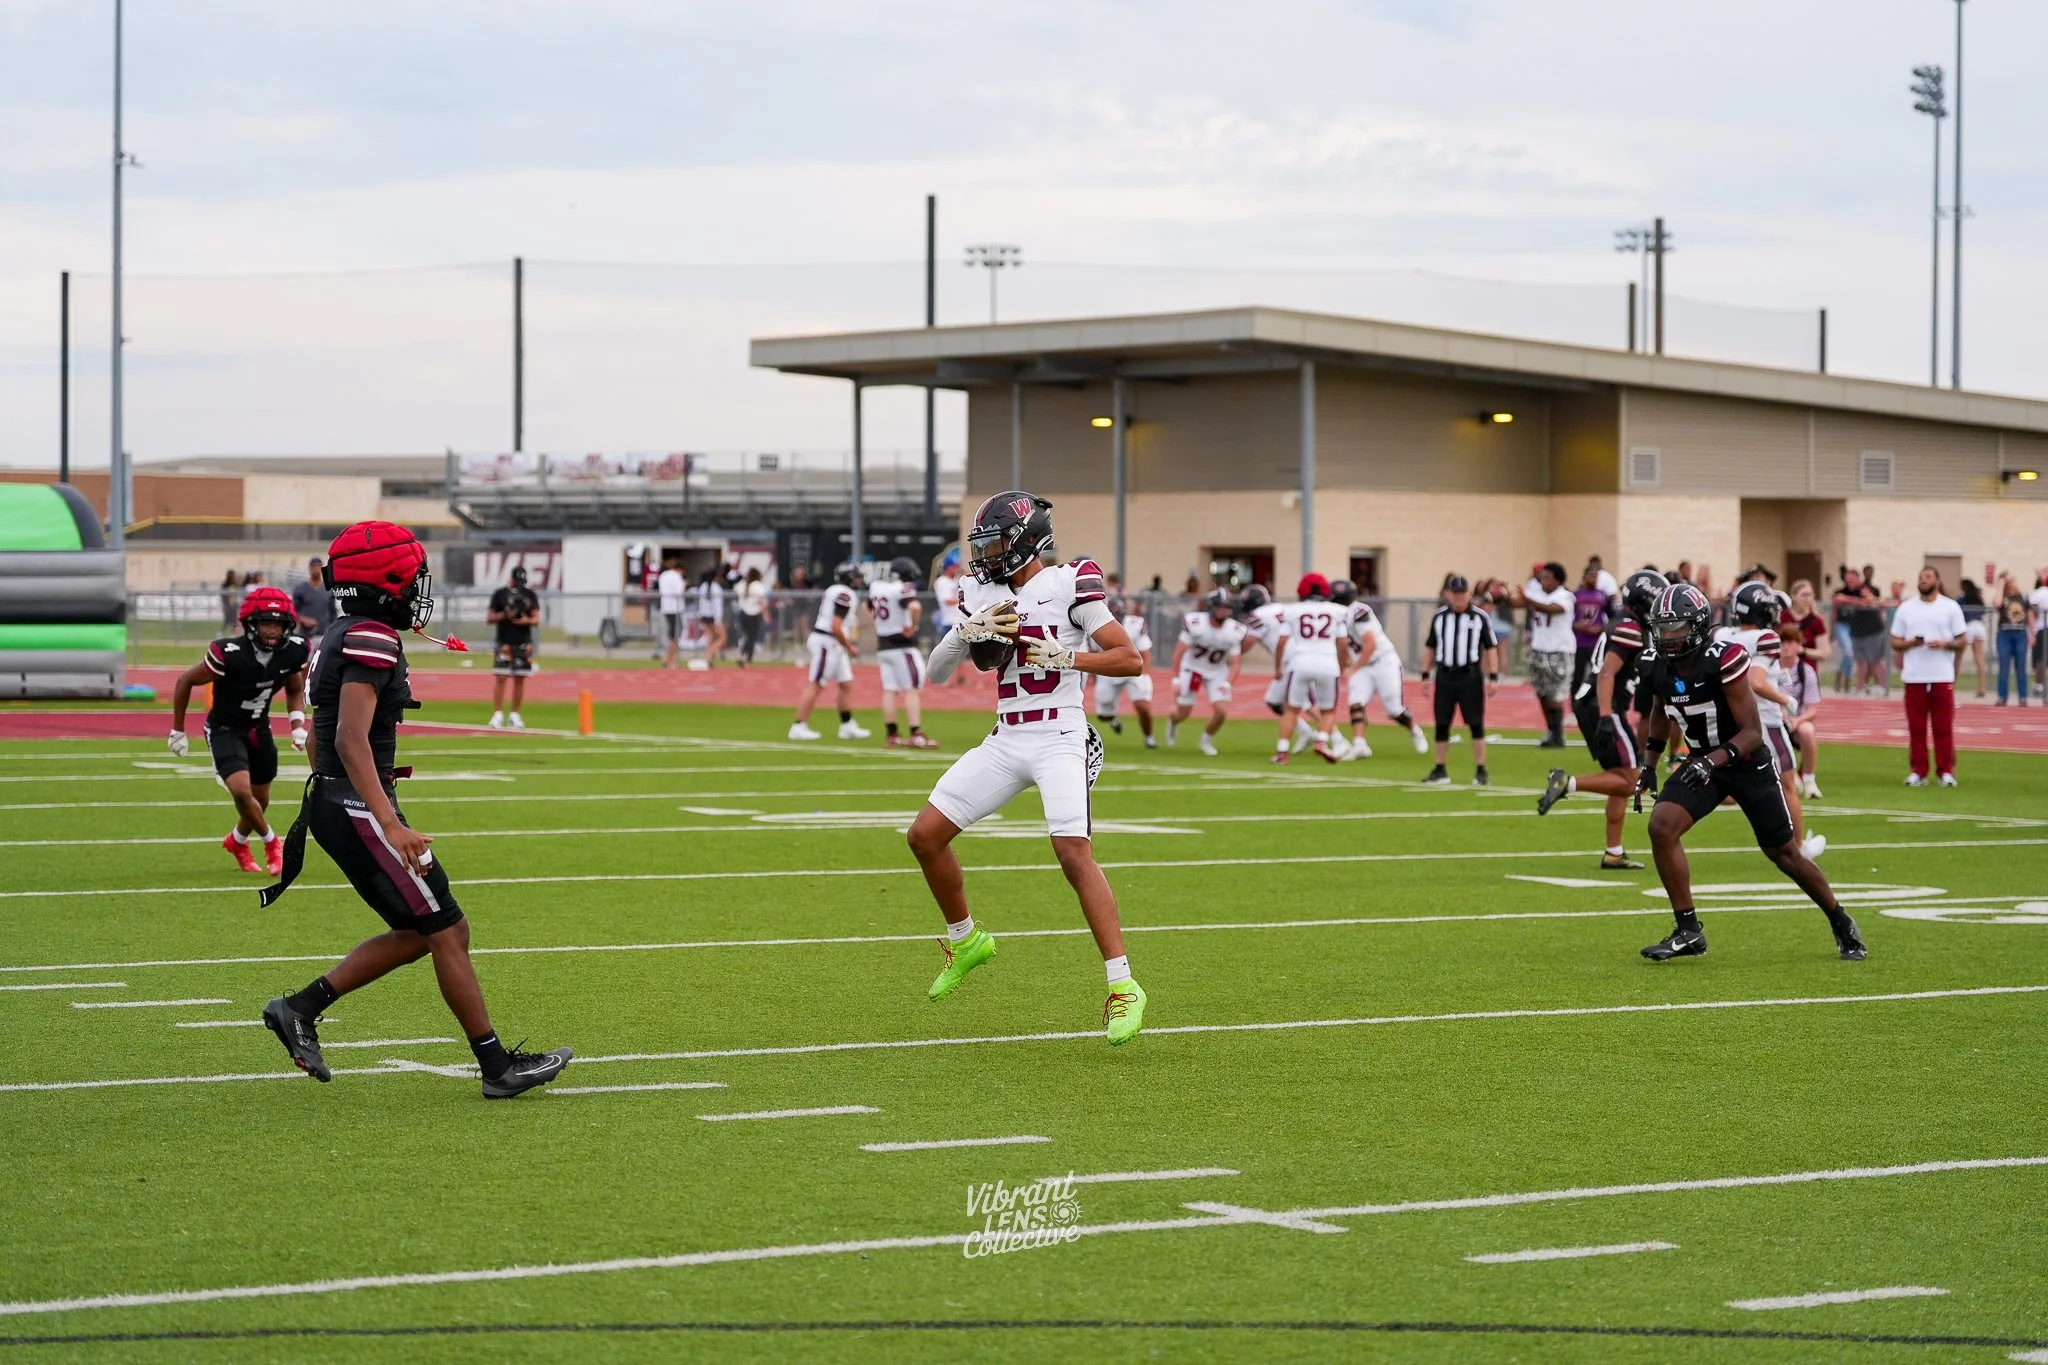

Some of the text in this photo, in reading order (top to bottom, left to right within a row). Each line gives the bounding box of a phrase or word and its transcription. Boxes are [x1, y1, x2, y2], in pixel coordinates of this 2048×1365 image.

[1008, 497, 1032, 519] W
[331, 587, 358, 597] ddell
[1300, 613, 1331, 639] 62
[240, 688, 273, 719] 4
[1664, 700, 1720, 749] 27
